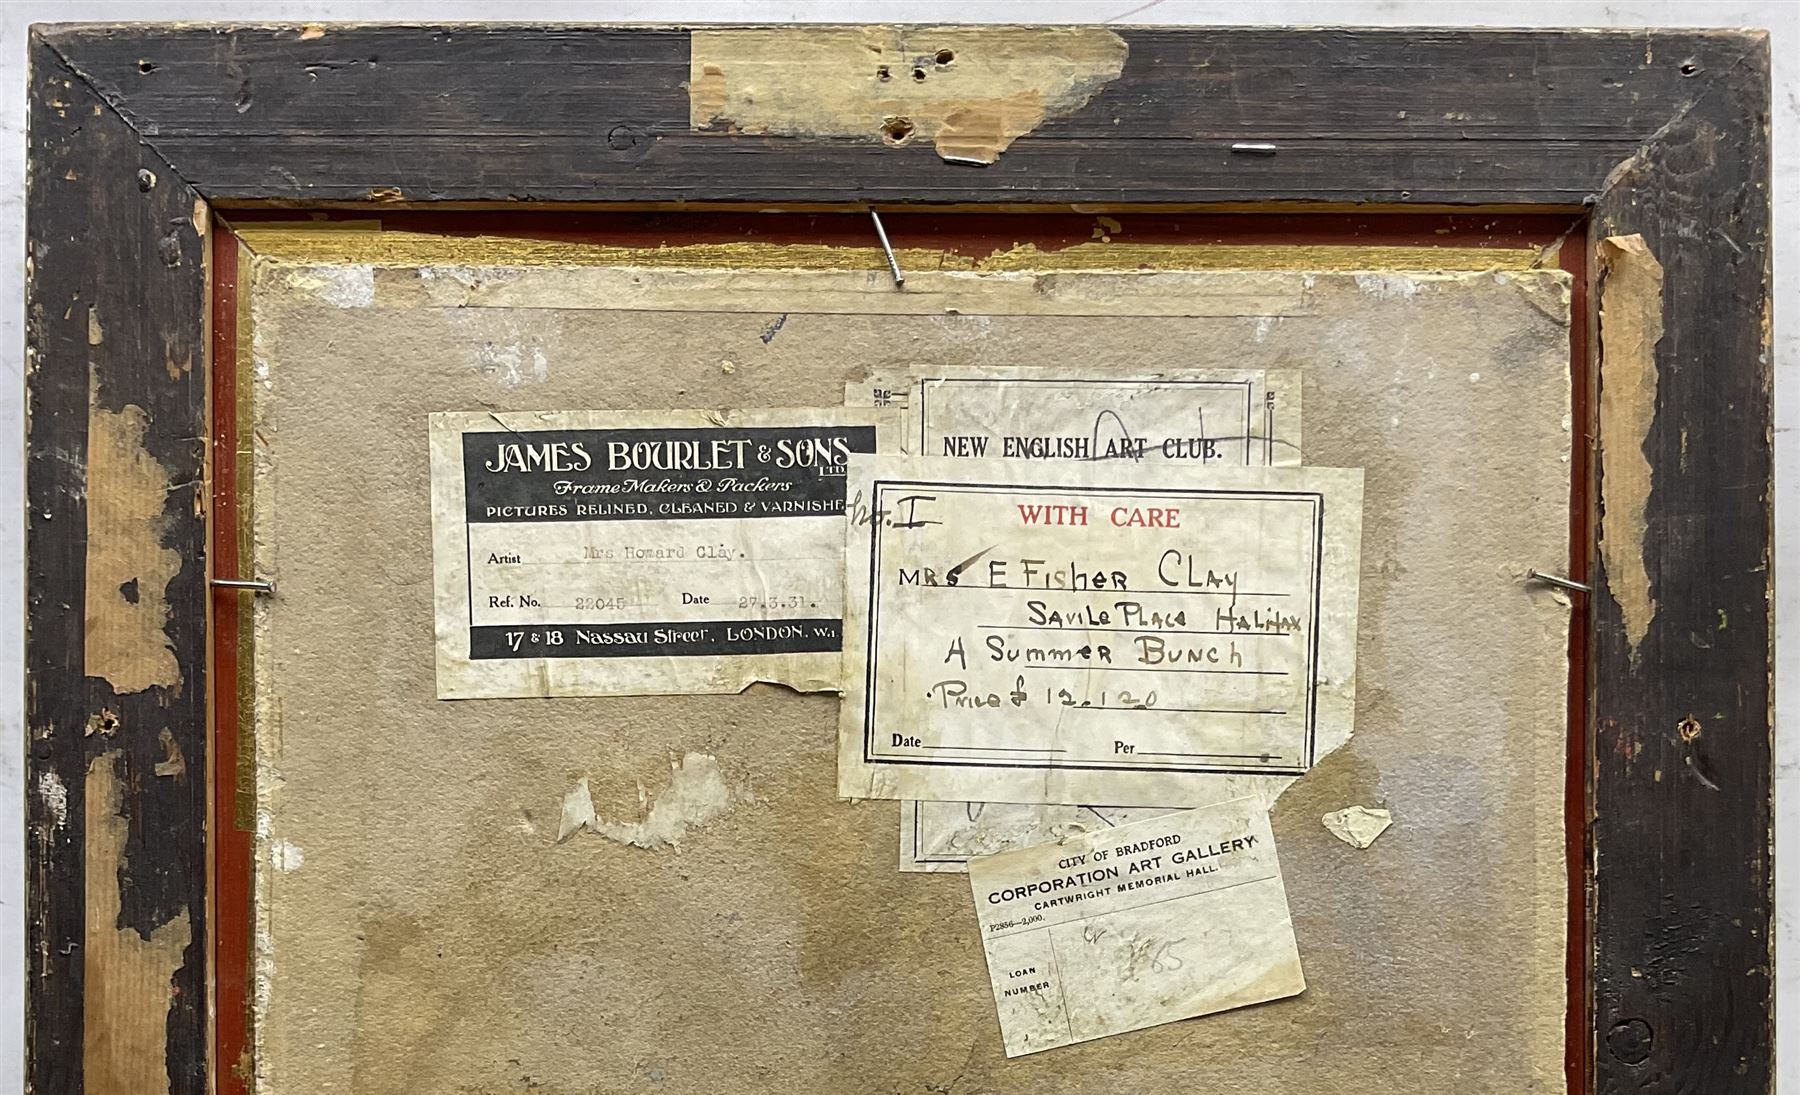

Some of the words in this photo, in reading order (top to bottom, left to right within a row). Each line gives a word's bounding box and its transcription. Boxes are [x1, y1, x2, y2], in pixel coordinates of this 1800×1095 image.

[485, 441, 591, 473] JAMES
[607, 437, 751, 471] BOURLET
[757, 444, 772, 462] &
[775, 437, 850, 468] SONS
[943, 436, 989, 458] NEW
[1002, 436, 1090, 459] ENGLISH
[1105, 437, 1148, 459] ART
[1162, 438, 1223, 459] CLUB.
[553, 479, 620, 496] Frame
[621, 477, 694, 494] Makers
[716, 476, 793, 493] Packers
[487, 504, 568, 518] PICTURES
[659, 501, 737, 515] CLEANED
[743, 501, 756, 513] &
[1018, 504, 1088, 528] WITH
[1111, 508, 1180, 528] CARE
[487, 552, 521, 565] Artist
[989, 561, 1007, 588] E
[488, 595, 515, 609] Ref.
[519, 595, 541, 608] No.
[575, 597, 625, 610] 22045
[682, 592, 709, 605] Date
[505, 631, 525, 651] 17
[545, 629, 564, 646] 18
[576, 629, 648, 645] Nassau
[944, 636, 966, 670] A
[891, 733, 922, 749] Date
[1114, 741, 1136, 754] Per
[1058, 854, 1086, 871] CITY
[1094, 848, 1109, 862] OF
[1115, 834, 1182, 857] BRADFORD
[988, 866, 1119, 905] CORPORATION
[1128, 856, 1162, 875] ART
[1171, 835, 1256, 865] GALLERY
[1034, 887, 1111, 911] CARTWRIGHT
[1117, 873, 1181, 894] MEMORIAL
[1186, 864, 1219, 880] HALL.
[1009, 967, 1036, 979] LOAN
[1003, 981, 1050, 997] NUMBER
